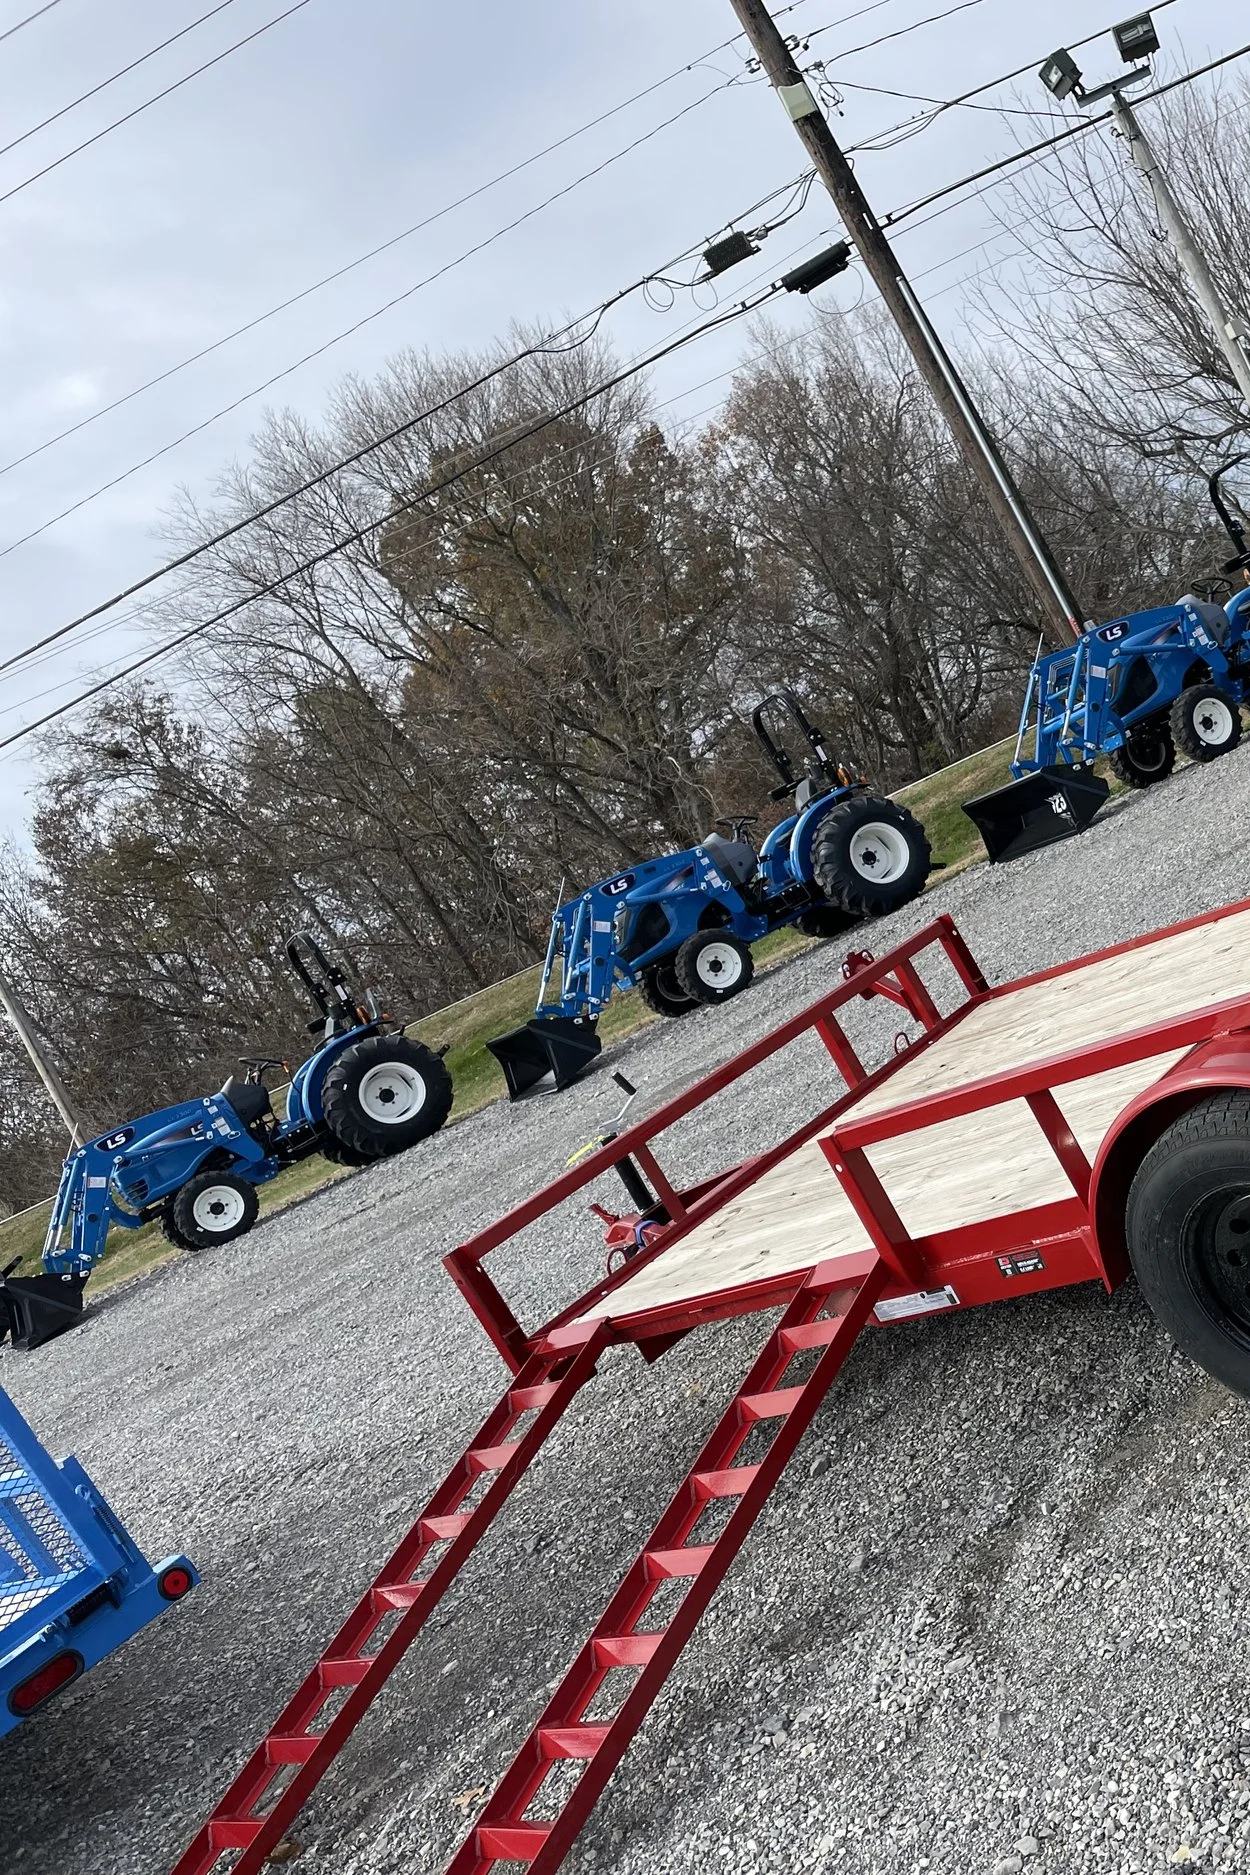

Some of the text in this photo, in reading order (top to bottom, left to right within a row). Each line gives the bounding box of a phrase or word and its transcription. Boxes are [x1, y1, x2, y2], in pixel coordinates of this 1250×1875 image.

[1106, 626, 1122, 641] LS
[610, 879, 628, 894] LS
[106, 1133, 127, 1150] LS
